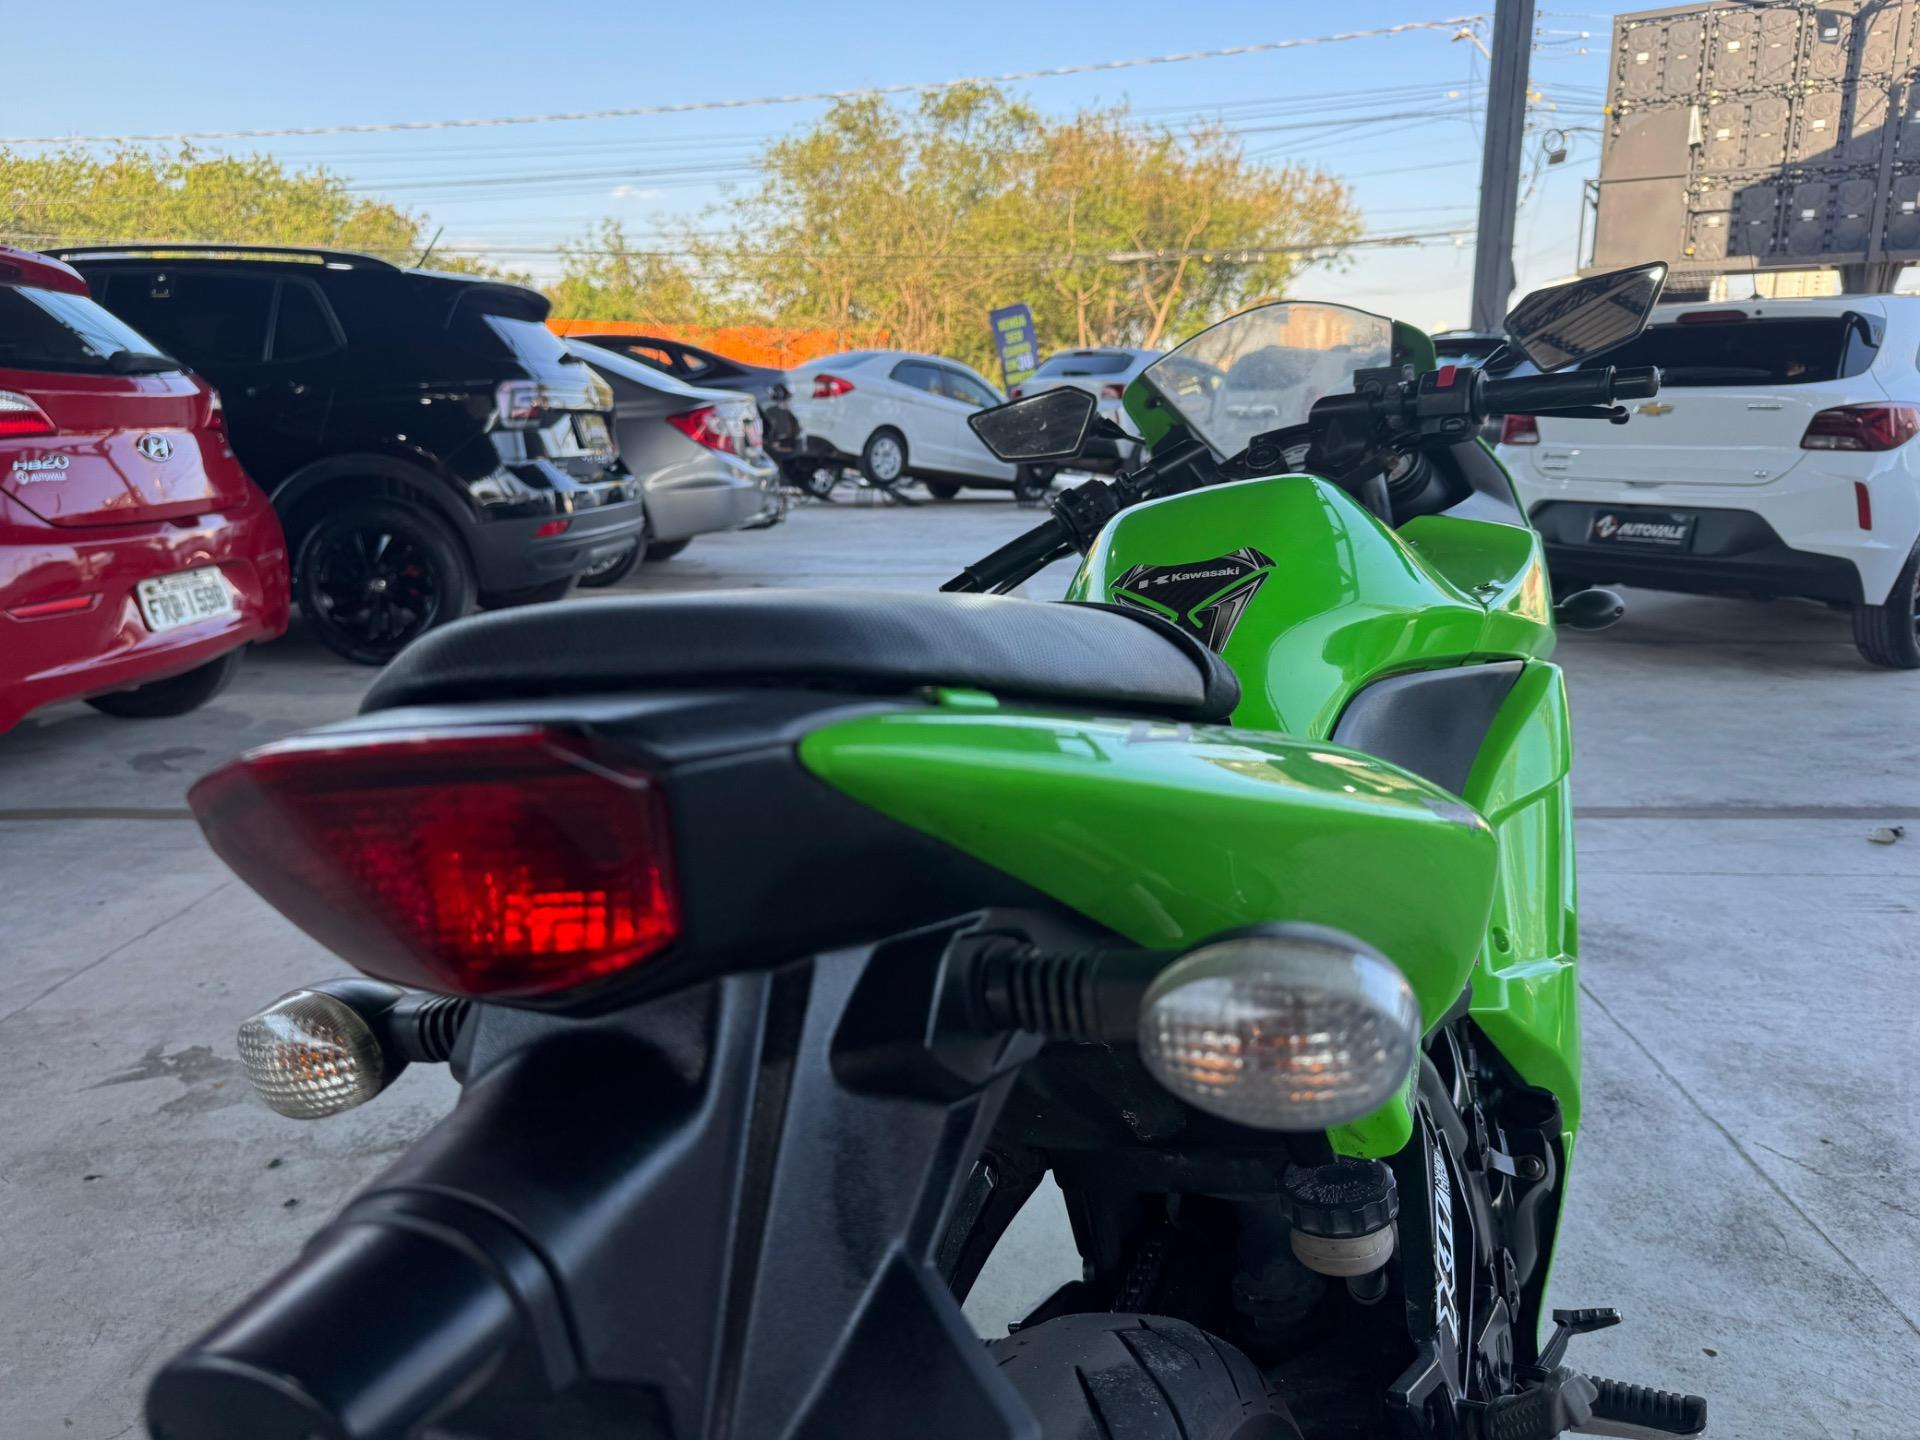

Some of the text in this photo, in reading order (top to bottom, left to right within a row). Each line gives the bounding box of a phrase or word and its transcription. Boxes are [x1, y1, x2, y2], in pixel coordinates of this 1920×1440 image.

[13, 455, 69, 470] HB20
[31, 471, 67, 481] AUTOVALE
[1616, 522, 1687, 539] AUTOVALE
[1171, 567, 1240, 582] Kawasaki
